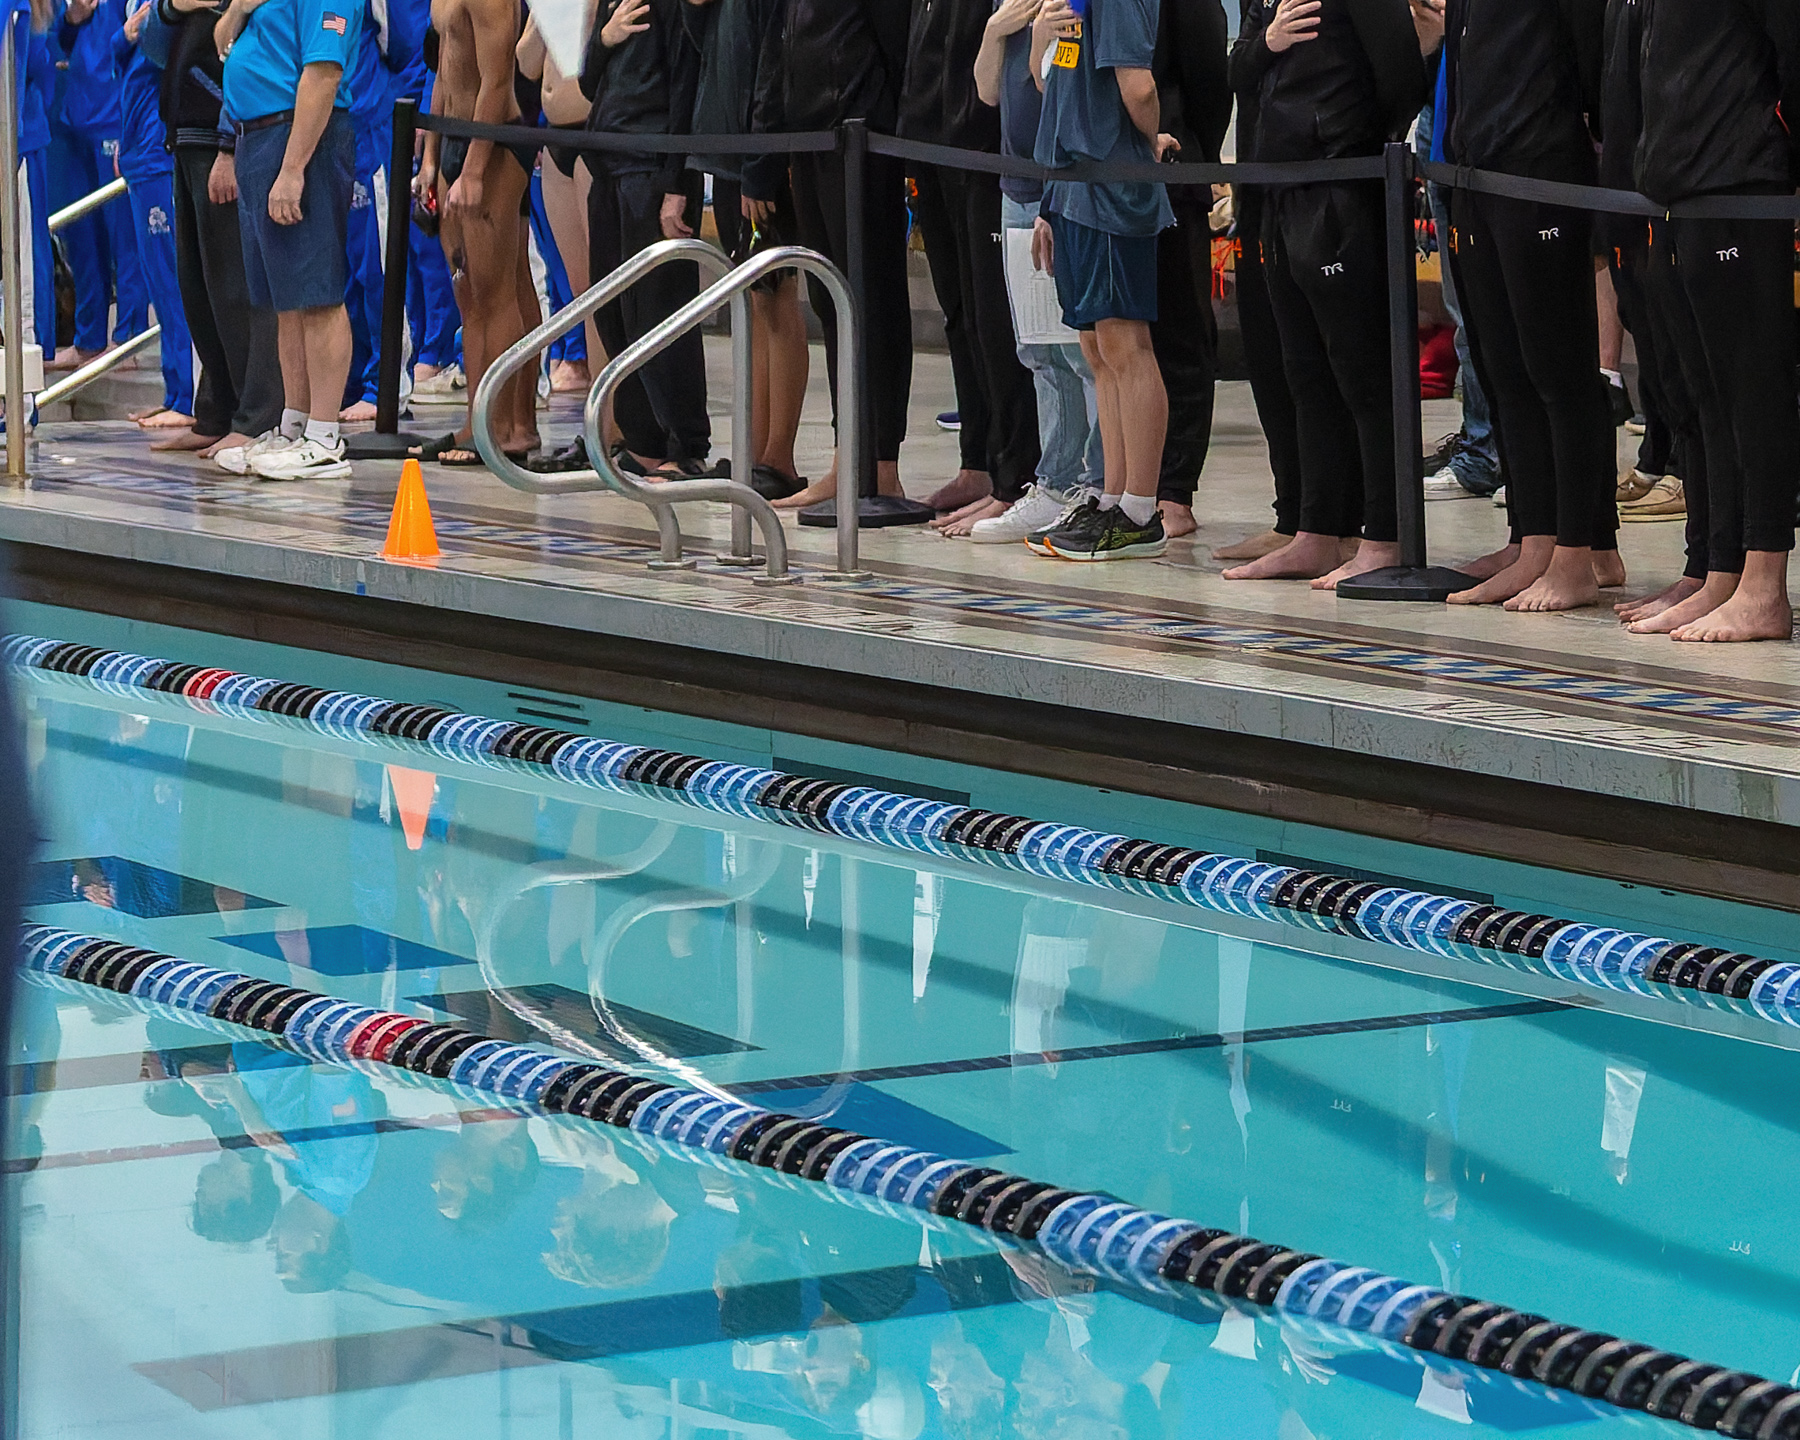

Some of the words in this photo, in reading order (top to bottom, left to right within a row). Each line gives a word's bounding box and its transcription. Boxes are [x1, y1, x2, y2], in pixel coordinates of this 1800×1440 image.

[990, 232, 1002, 243] TY
[1538, 227, 1560, 241] TYR
[1716, 247, 1740, 262] TYR
[1320, 262, 1344, 277] TYR
